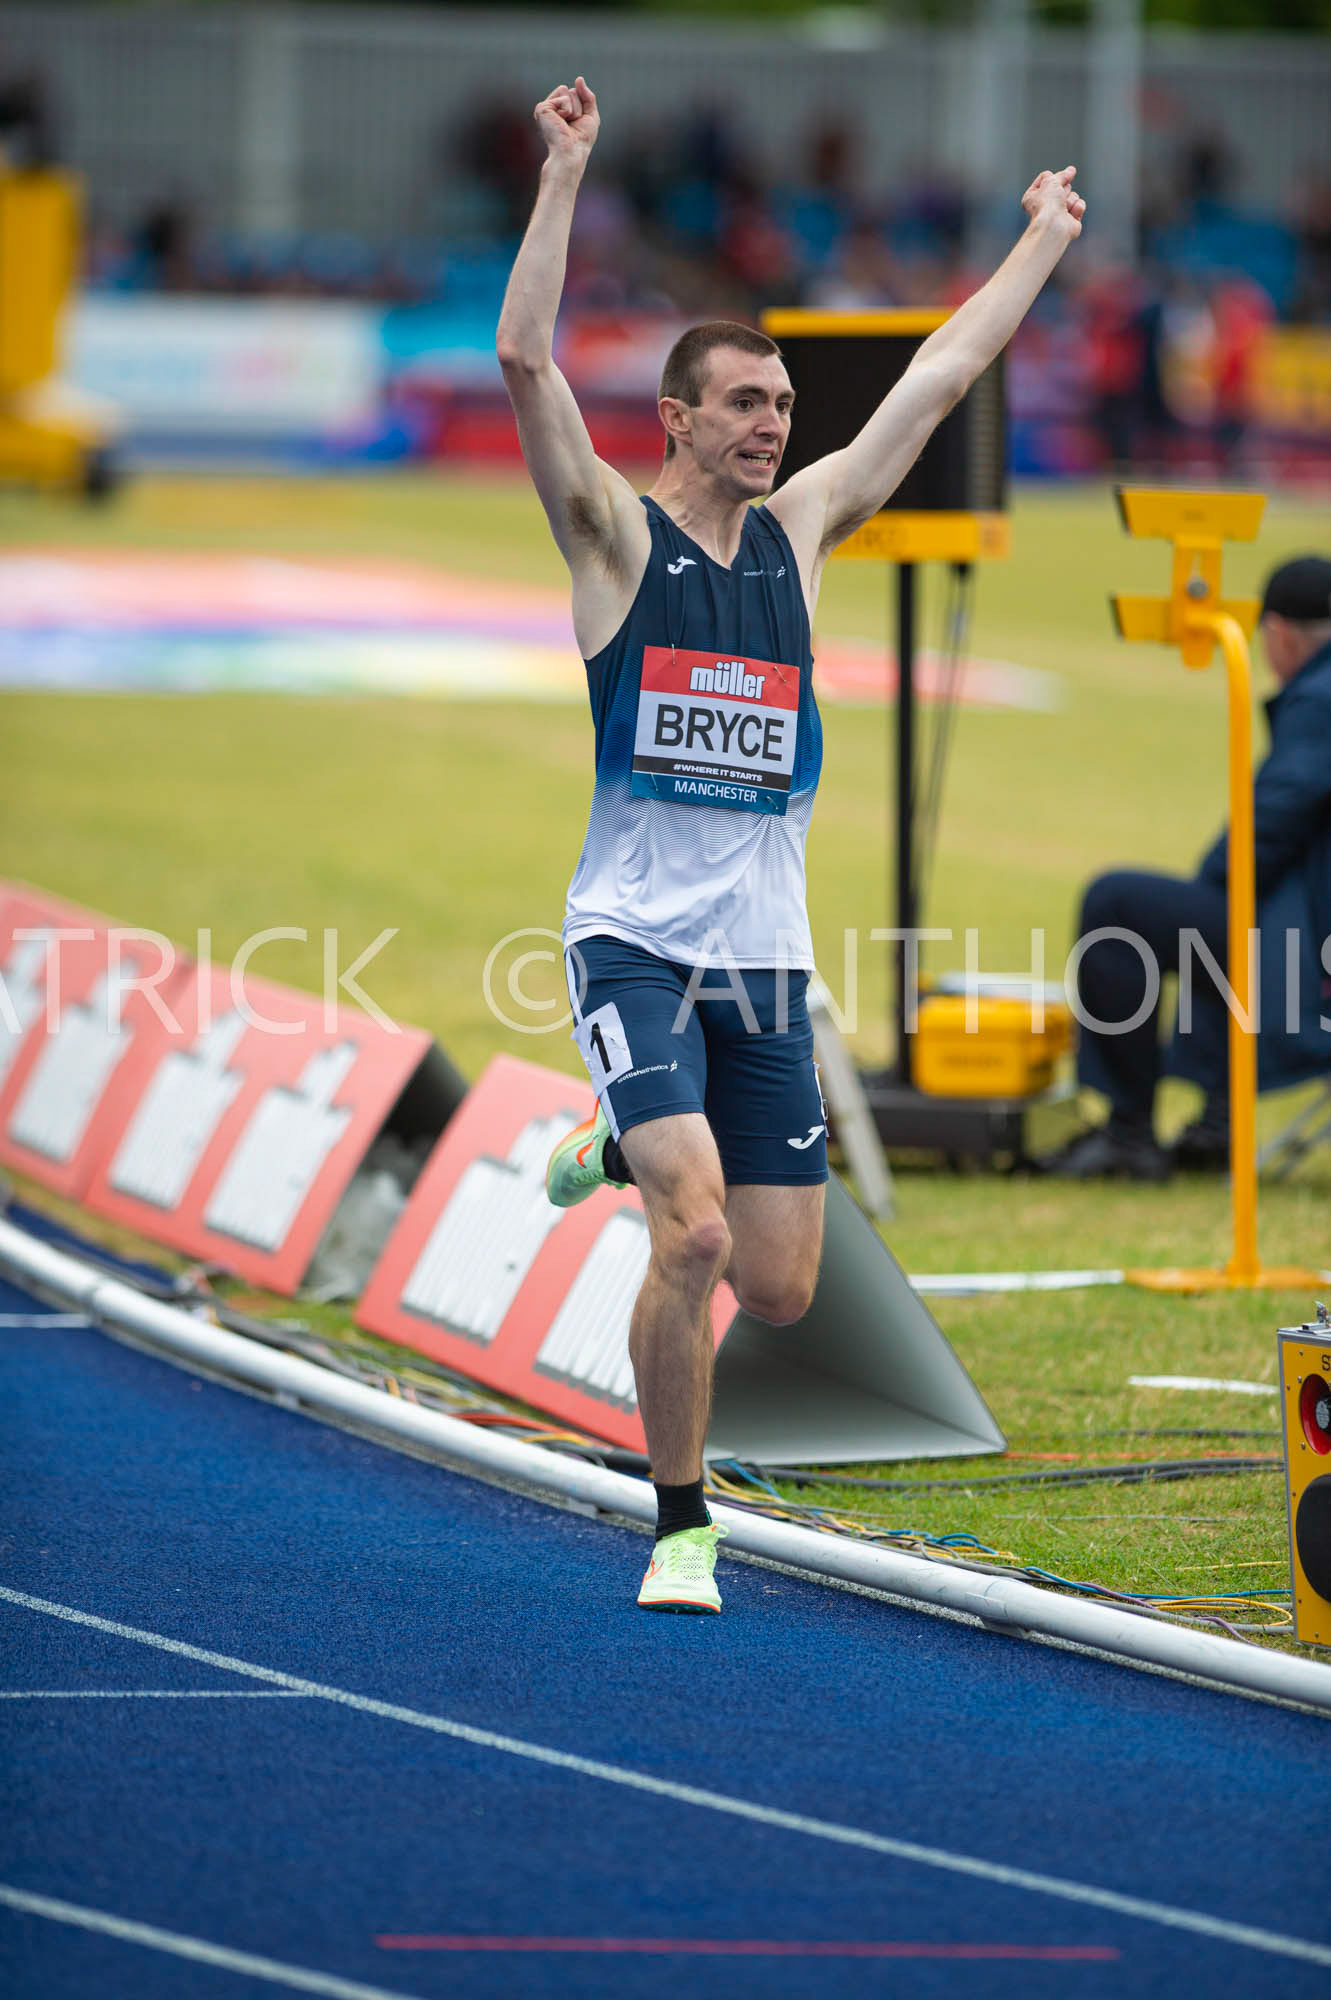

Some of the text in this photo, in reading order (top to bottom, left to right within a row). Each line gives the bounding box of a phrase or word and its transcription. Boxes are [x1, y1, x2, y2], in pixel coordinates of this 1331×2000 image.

[689, 661, 766, 700] müller
[654, 703, 785, 762] BRYCE
[673, 763, 763, 782] #WHERE IT STARTS
[674, 780, 758, 803] MANCHESTER
[590, 1022, 612, 1074] 1
